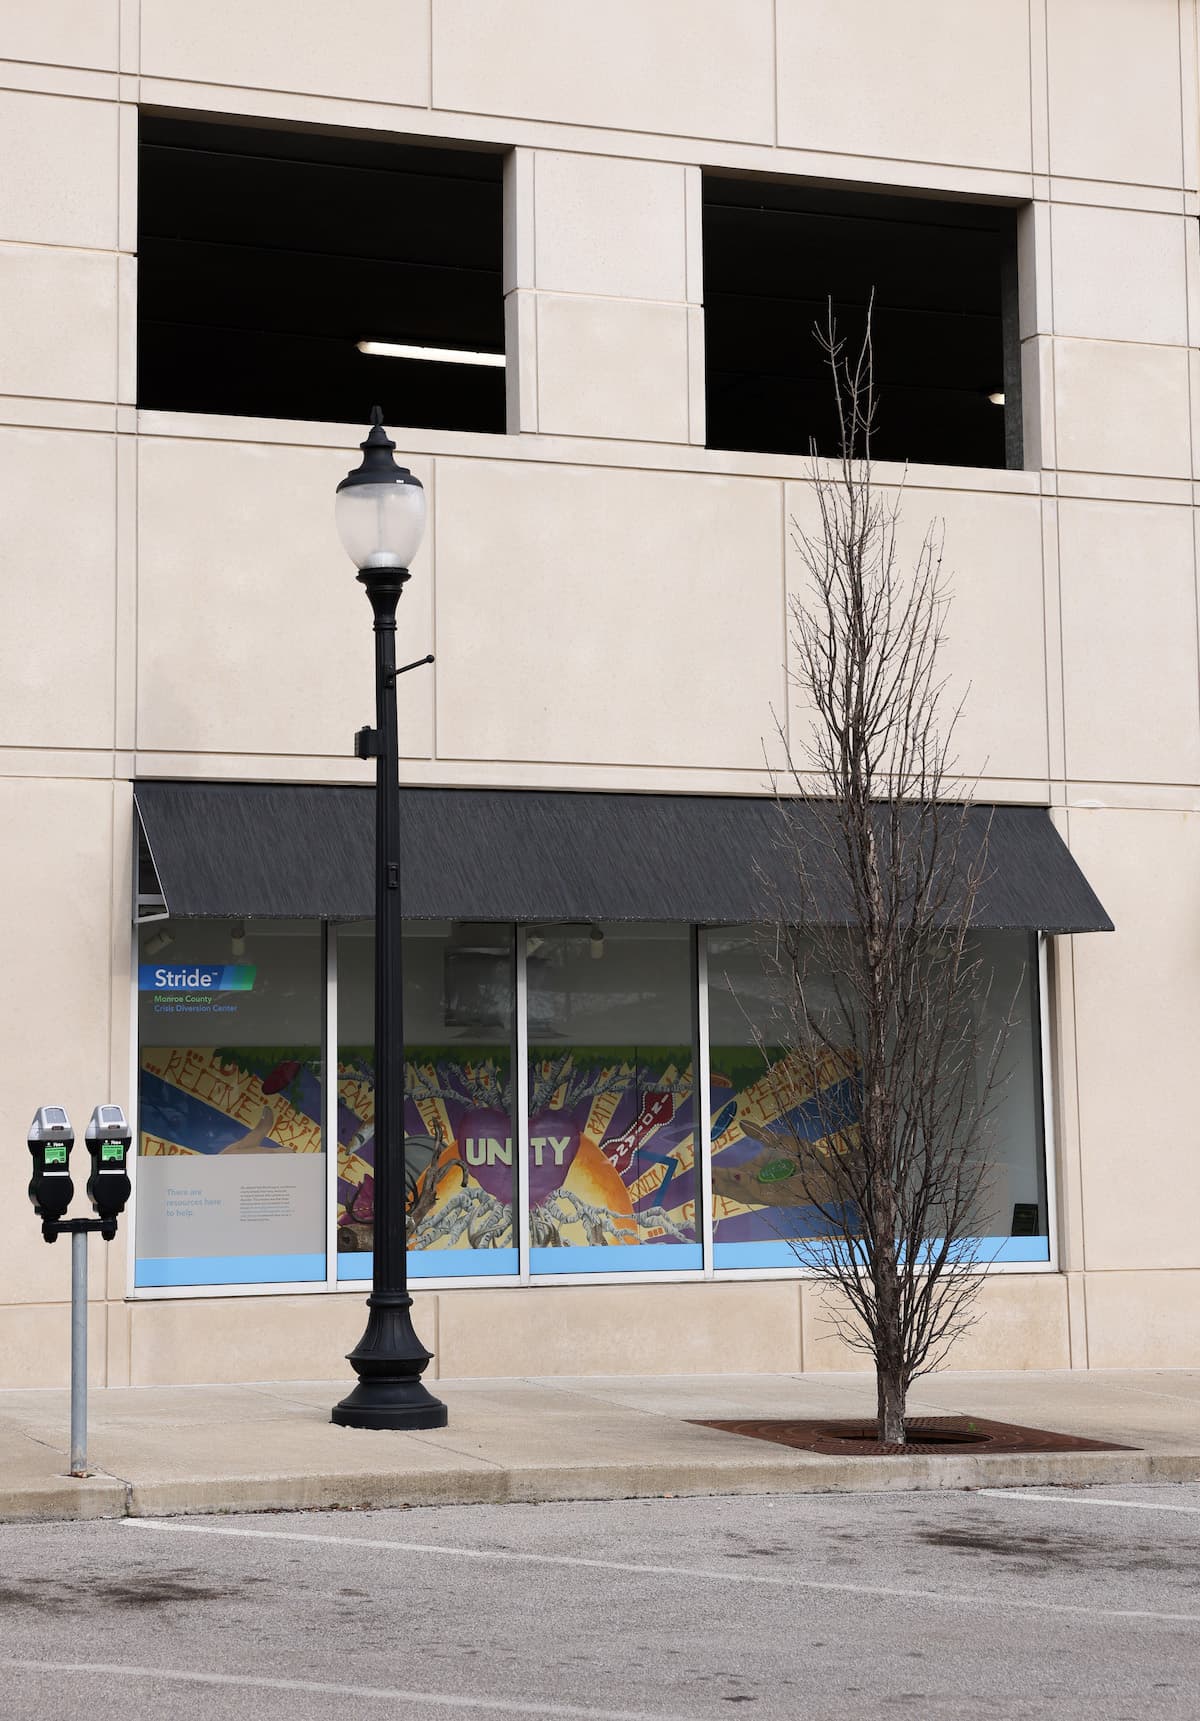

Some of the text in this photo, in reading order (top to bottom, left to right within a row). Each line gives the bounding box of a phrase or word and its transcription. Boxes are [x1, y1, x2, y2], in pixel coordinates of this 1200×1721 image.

[154, 995, 213, 1004] Monroe County
[176, 1004, 212, 1012] Diversion
[466, 1136, 571, 1166] UNTY
[167, 1188, 189, 1196] There
[204, 1198, 222, 1206] here
